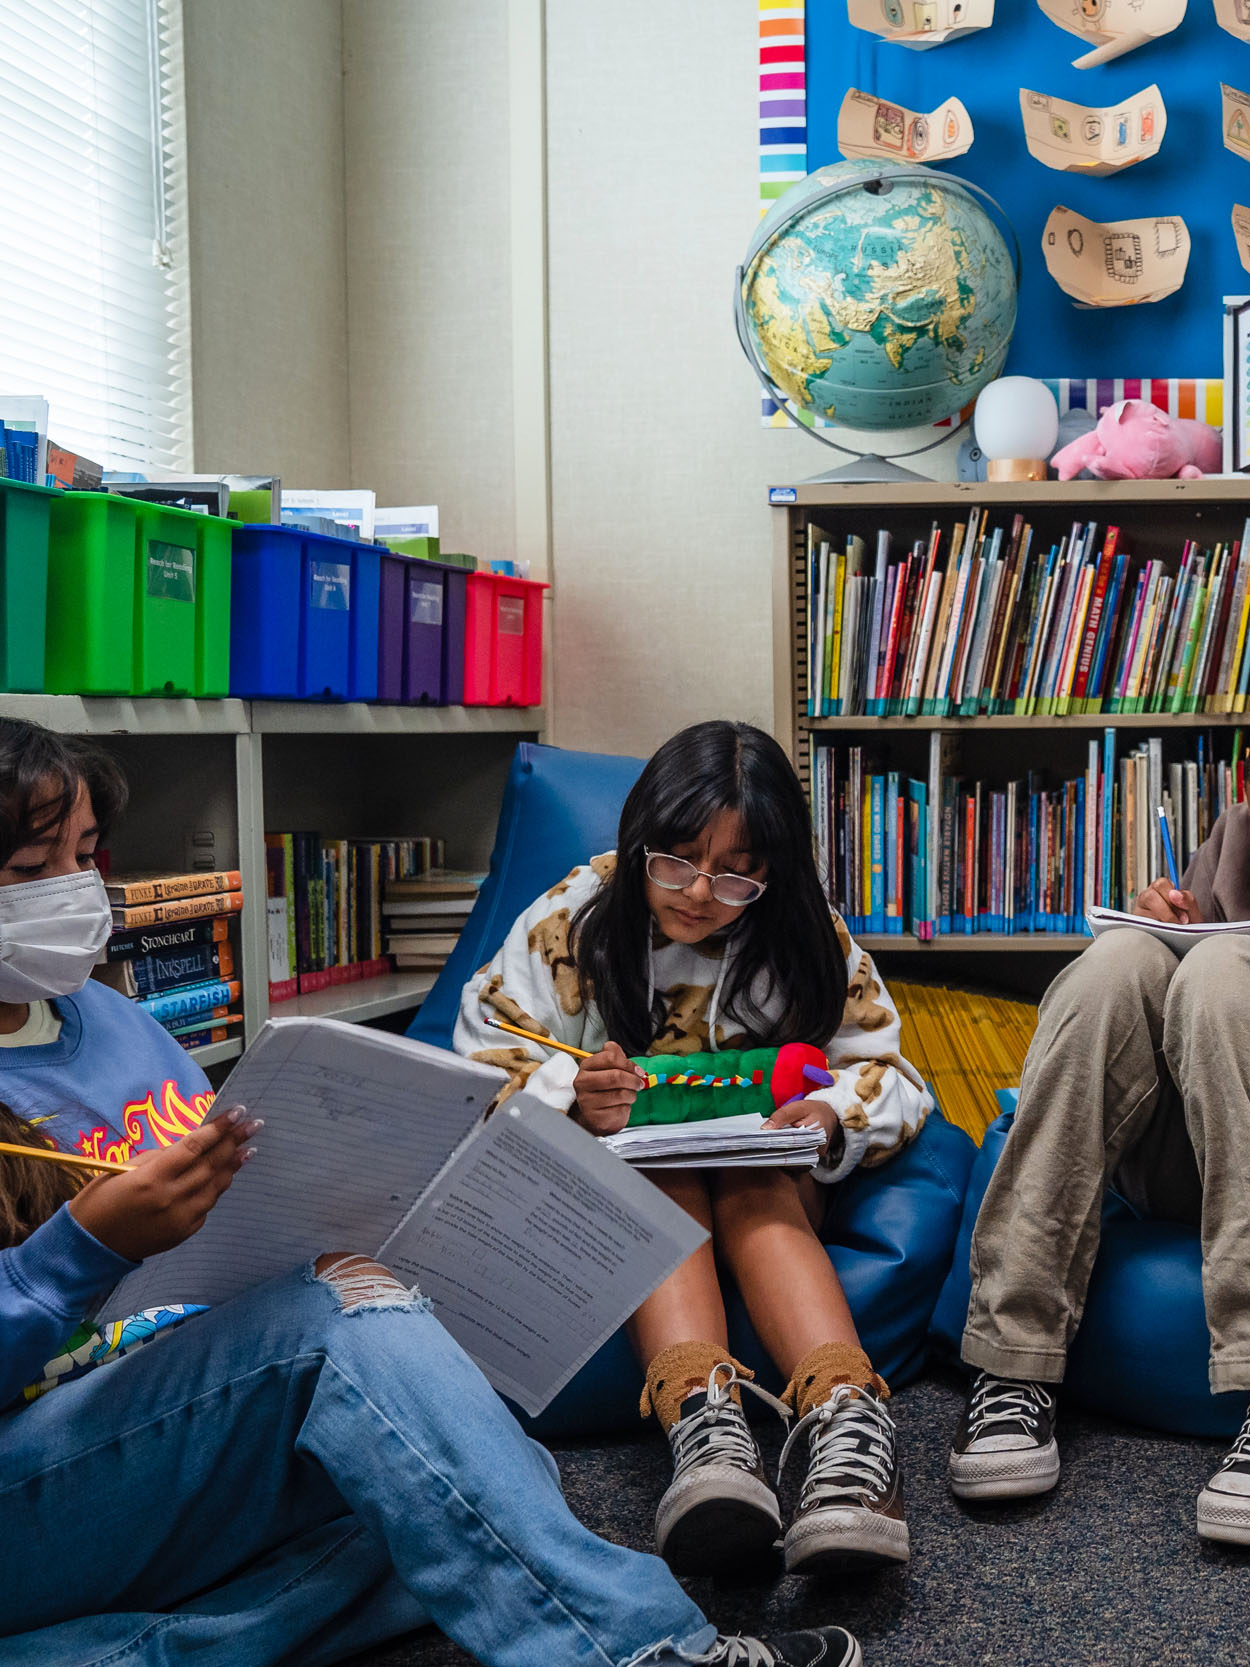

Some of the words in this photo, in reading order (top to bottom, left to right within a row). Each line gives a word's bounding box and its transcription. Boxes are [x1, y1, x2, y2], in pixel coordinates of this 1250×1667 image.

[1088, 596, 1102, 628] MATH
[1078, 630, 1095, 673] GENIUS
[943, 806, 951, 846] NOTABLE
[130, 888, 152, 900] FUNKE
[193, 878, 214, 890] BRAVE
[130, 911, 152, 924] FUNKE
[194, 901, 215, 913] BRAVE
[111, 943, 134, 952] FLETCHER
[156, 955, 205, 979] INKSPELL
[160, 988, 230, 1018] STARFISH
